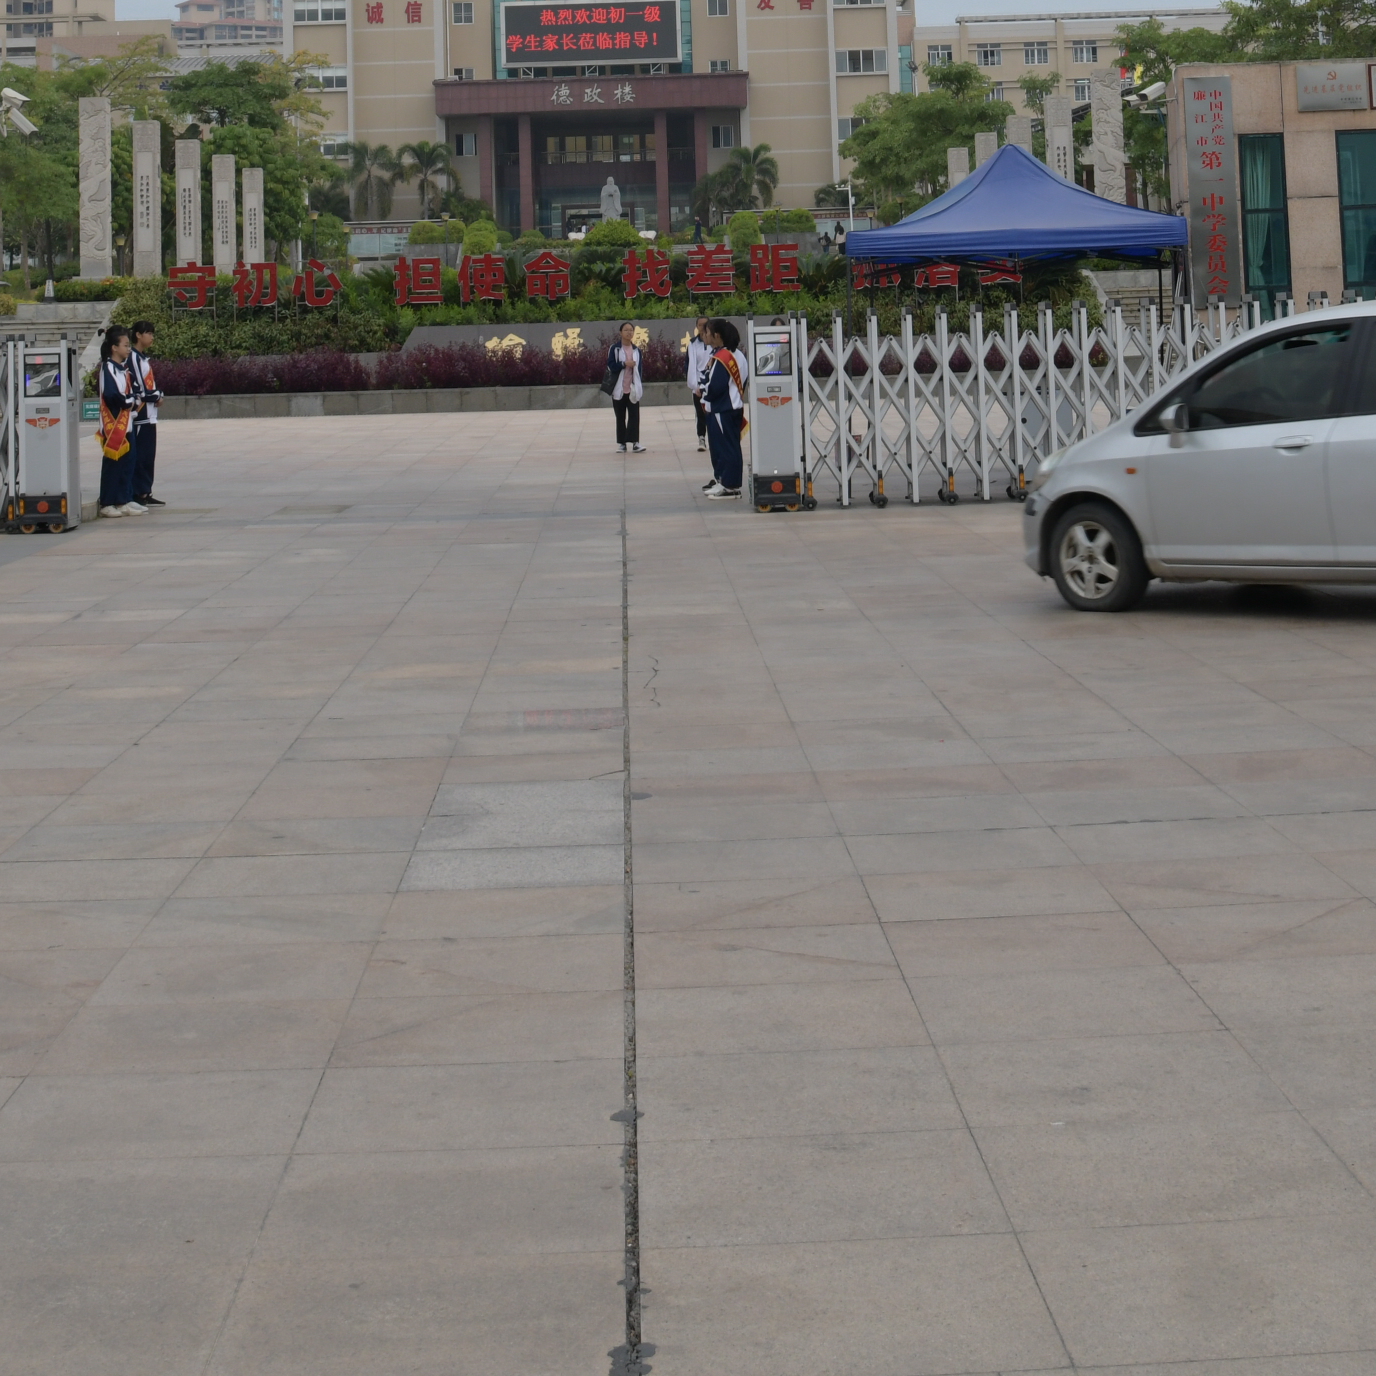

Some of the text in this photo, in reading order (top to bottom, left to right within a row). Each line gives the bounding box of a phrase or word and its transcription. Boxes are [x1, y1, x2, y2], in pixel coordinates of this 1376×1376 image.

[365, 1, 423, 25] 诚信
[540, 5, 661, 26] 热烈欢迎初一级
[506, 31, 658, 52] 学生家长莅临指导！
[550, 82, 636, 105] 德政楼
[1303, 84, 1363, 94] 先进基层党组织
[1192, 89, 1209, 147] 廉江市
[1209, 89, 1226, 146] 中国共产党
[1199, 150, 1230, 295] 第一中学委员会
[167, 258, 343, 310] 守初心
[393, 251, 572, 306] 担使命
[622, 243, 802, 298] 找差距
